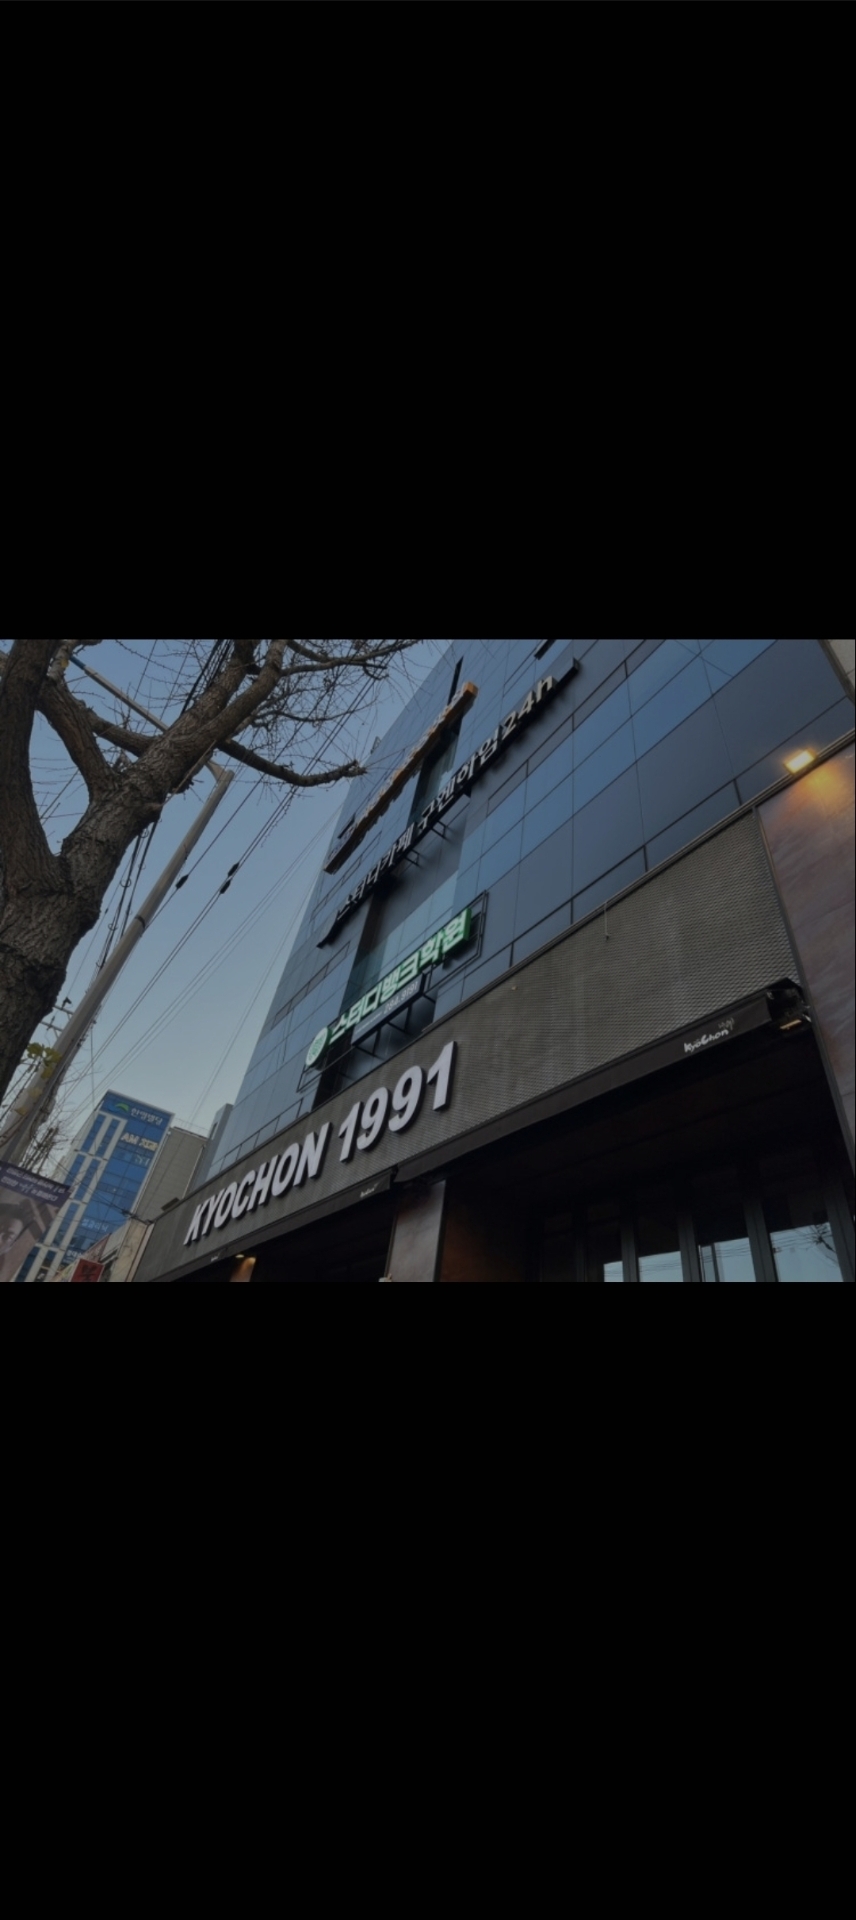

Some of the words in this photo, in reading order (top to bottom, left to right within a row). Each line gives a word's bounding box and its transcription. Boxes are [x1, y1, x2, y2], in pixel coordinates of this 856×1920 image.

[329, 909, 469, 1044] 스터디뱅크학원
[183, 1121, 333, 1248] KYOCHON
[338, 1041, 456, 1162] 1991
